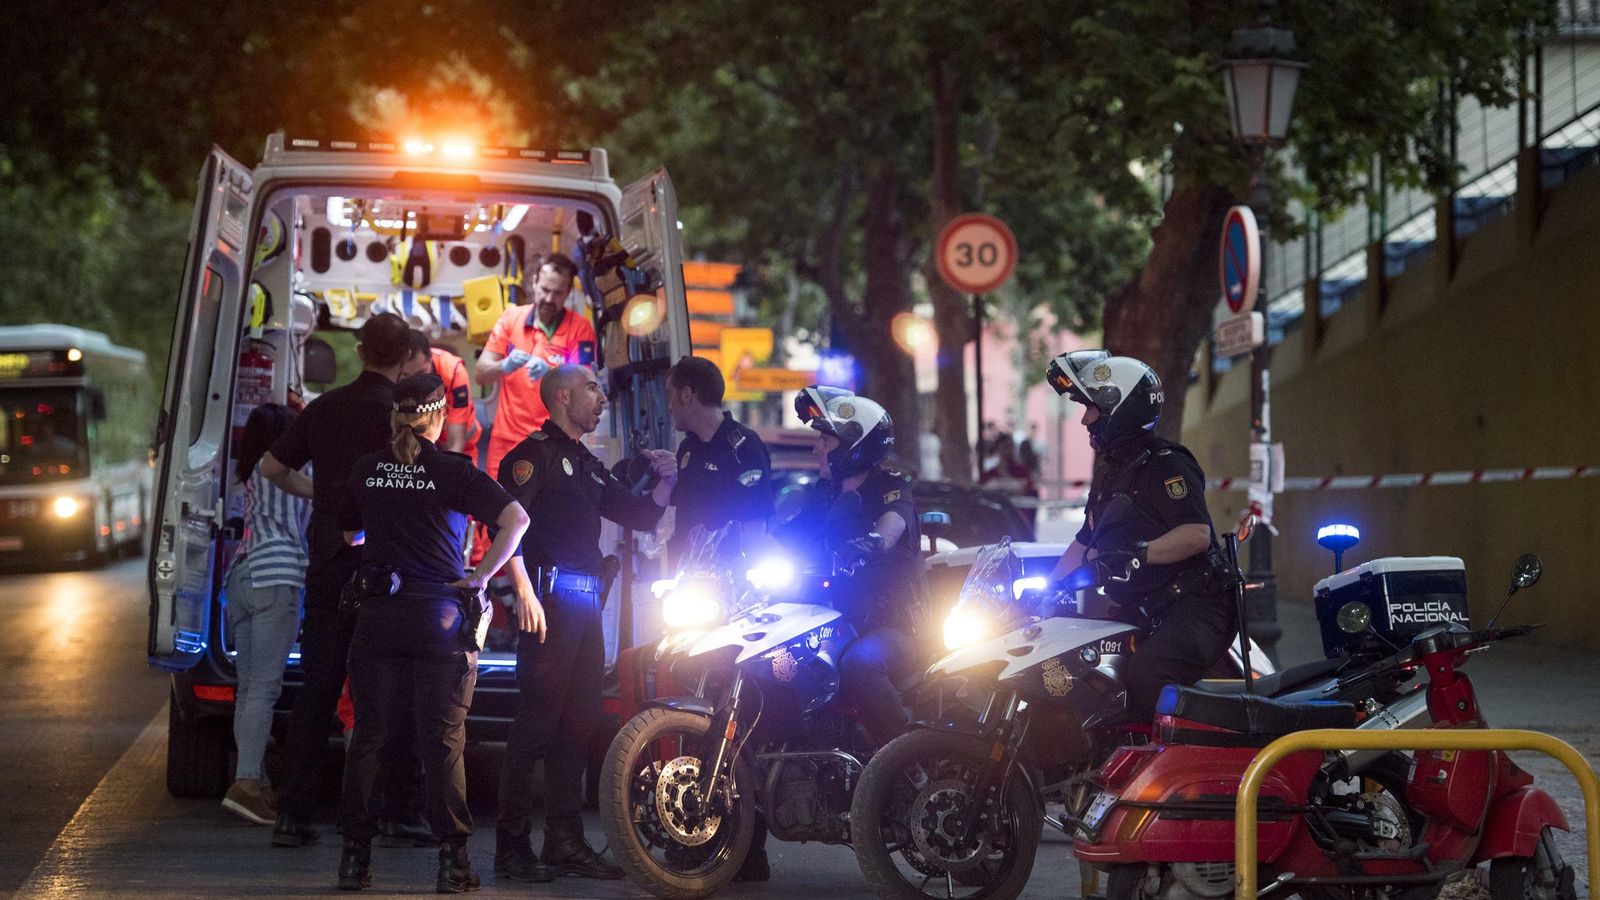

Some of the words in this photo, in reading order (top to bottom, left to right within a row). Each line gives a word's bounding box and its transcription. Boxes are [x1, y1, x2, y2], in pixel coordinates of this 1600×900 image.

[956, 242, 997, 268] 30
[376, 462, 426, 474] POLICIA
[387, 472, 414, 480] LOCAL
[365, 477, 436, 490] GRANADA
[1390, 600, 1451, 613] POLICÍA
[1391, 612, 1470, 623] NACIONAL
